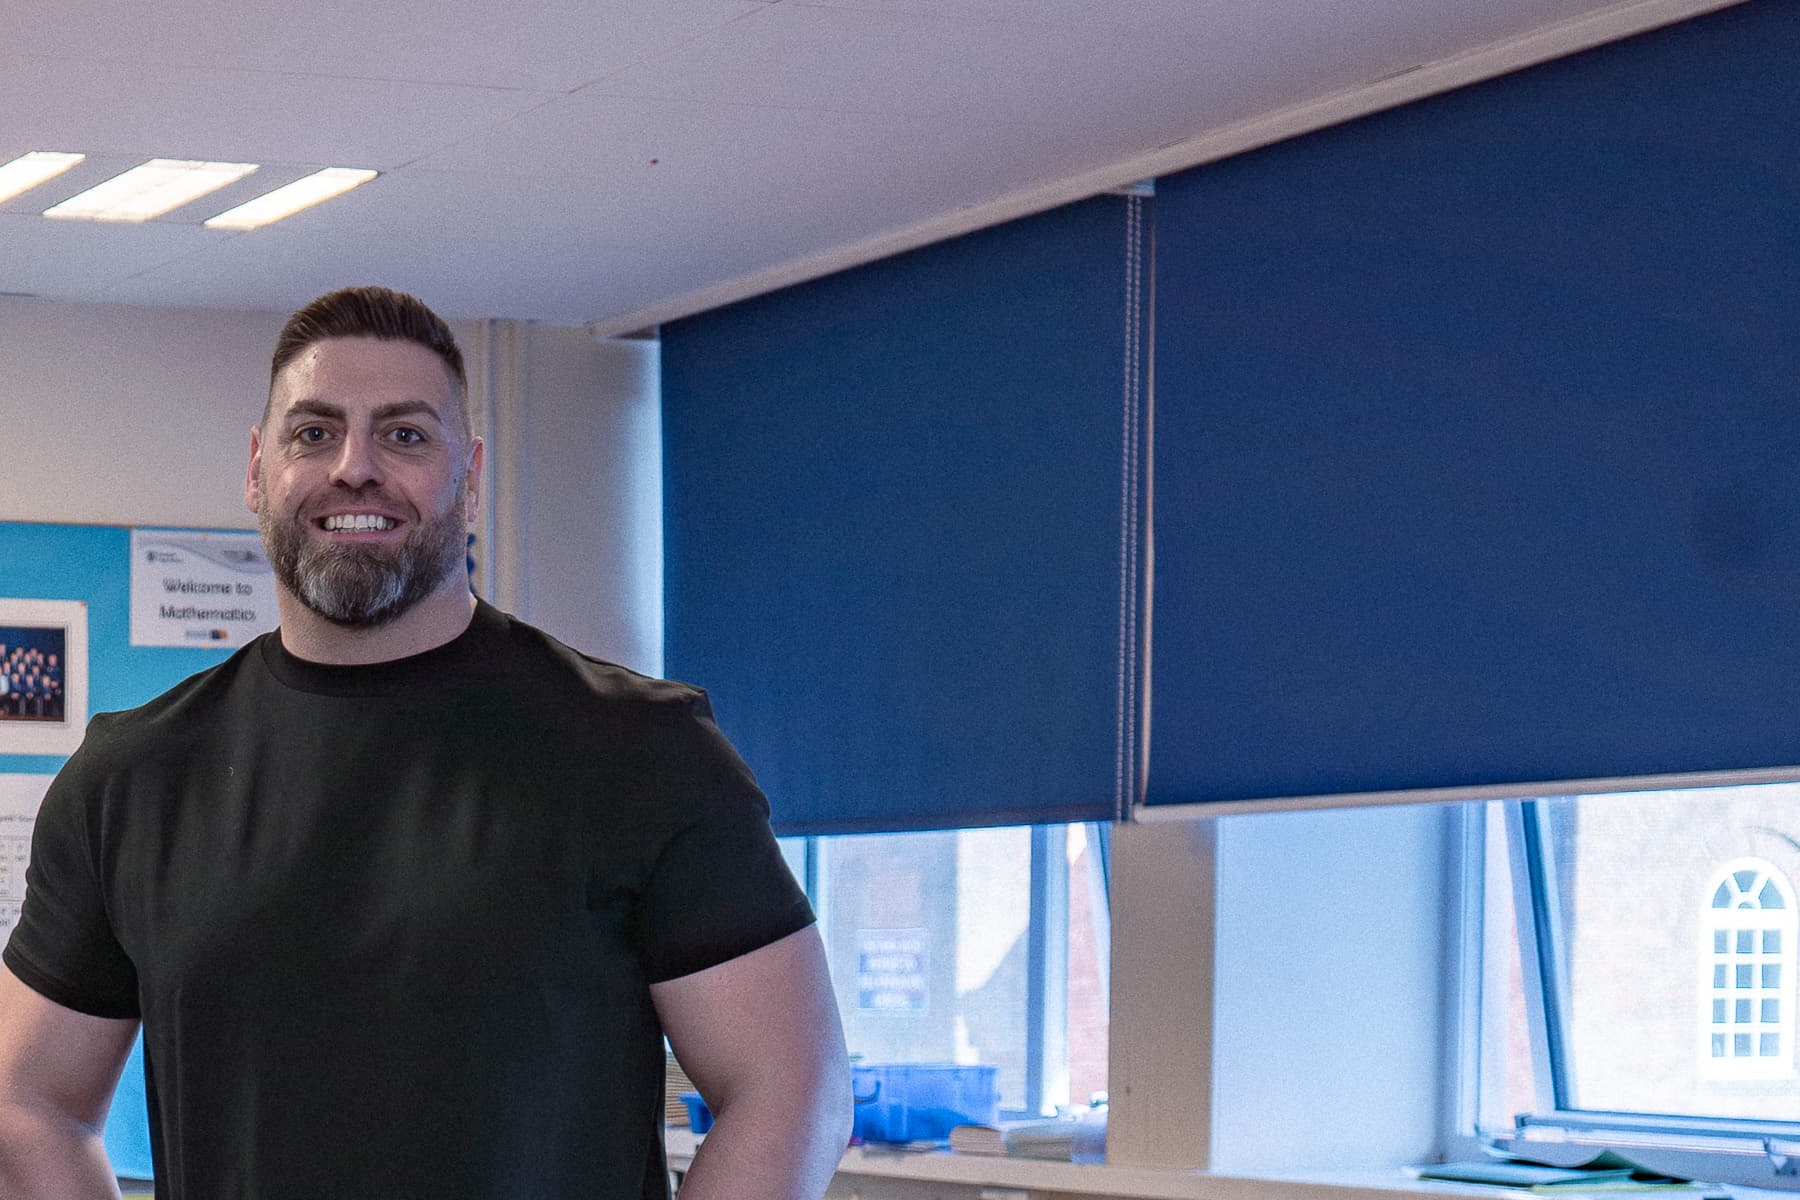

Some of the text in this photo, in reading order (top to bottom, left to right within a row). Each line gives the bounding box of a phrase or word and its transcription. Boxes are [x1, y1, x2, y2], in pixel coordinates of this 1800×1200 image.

[162, 579, 253, 595] Welcome to
[160, 605, 256, 621] Mathematics
